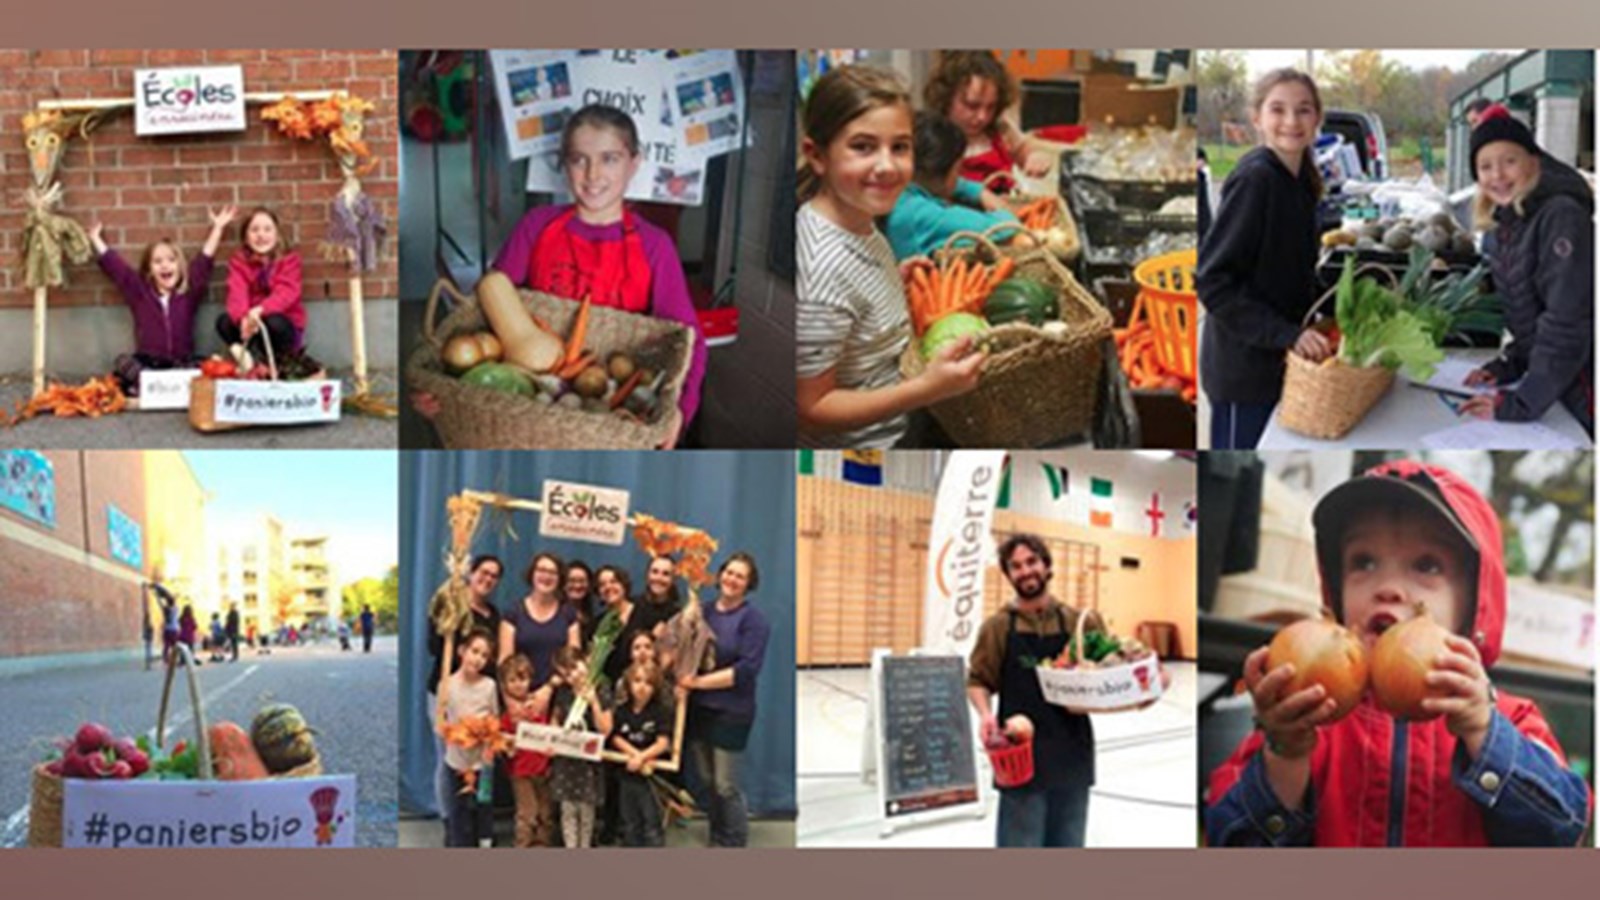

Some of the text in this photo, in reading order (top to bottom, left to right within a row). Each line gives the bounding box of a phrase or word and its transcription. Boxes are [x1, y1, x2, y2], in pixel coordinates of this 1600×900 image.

[142, 72, 237, 108] Écoles
[224, 394, 316, 412] #paniersbio
[548, 485, 621, 524] Écoles
[946, 465, 993, 642] équiterre
[84, 810, 301, 847] #paniersbio
